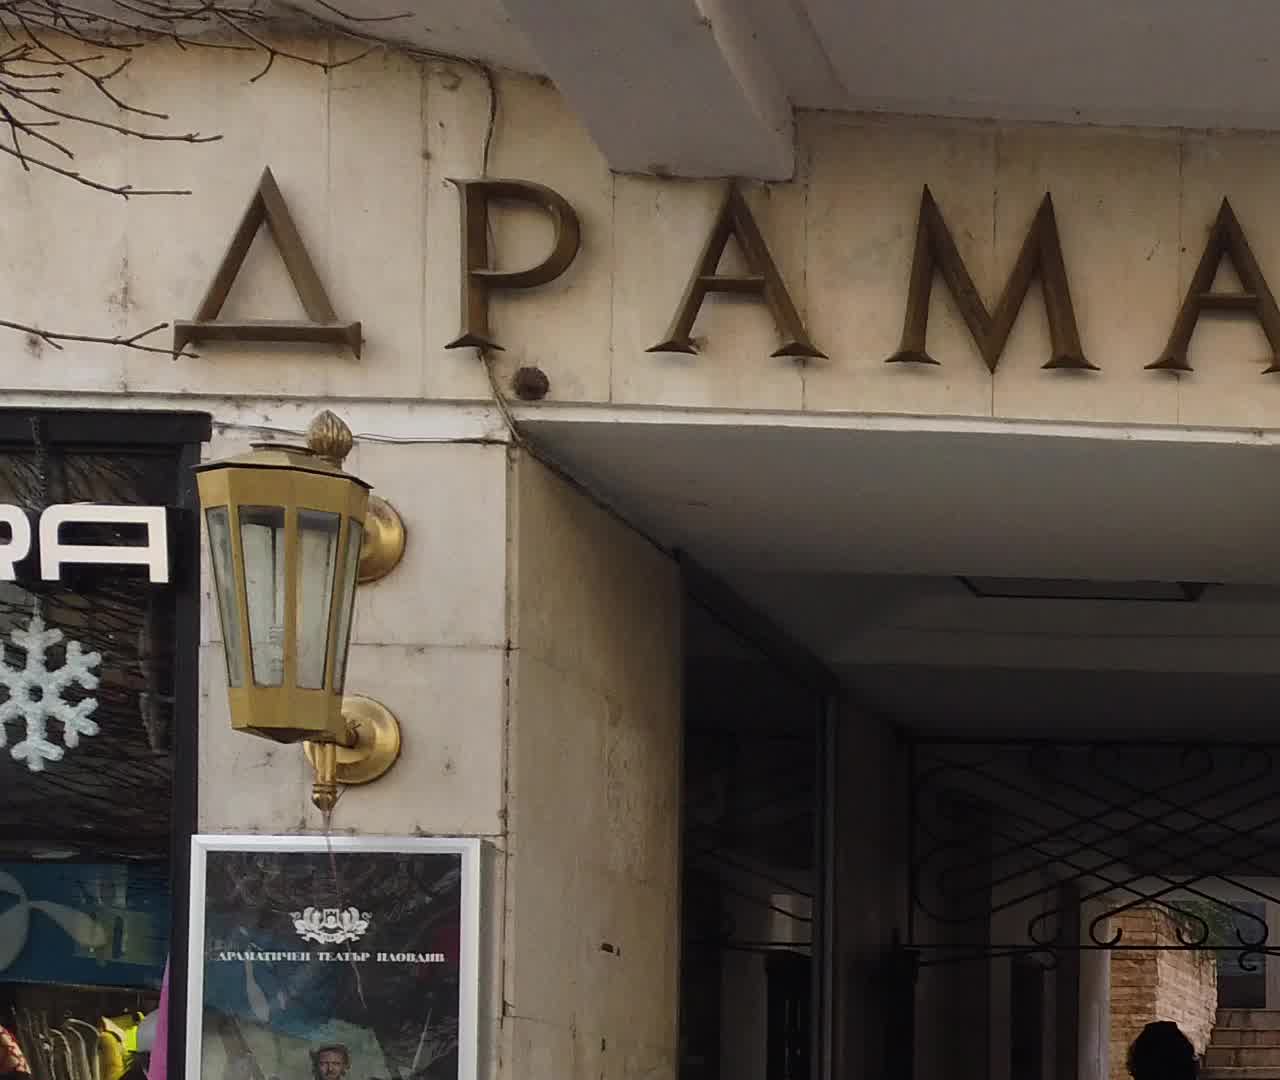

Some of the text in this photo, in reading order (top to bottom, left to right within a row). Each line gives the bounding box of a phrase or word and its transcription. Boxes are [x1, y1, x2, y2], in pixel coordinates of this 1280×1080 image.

[0, 503, 168, 583] A
[217, 951, 445, 963] ДРАМАТИЧЕН ТЕАТЪР ПЛОВДИВ
